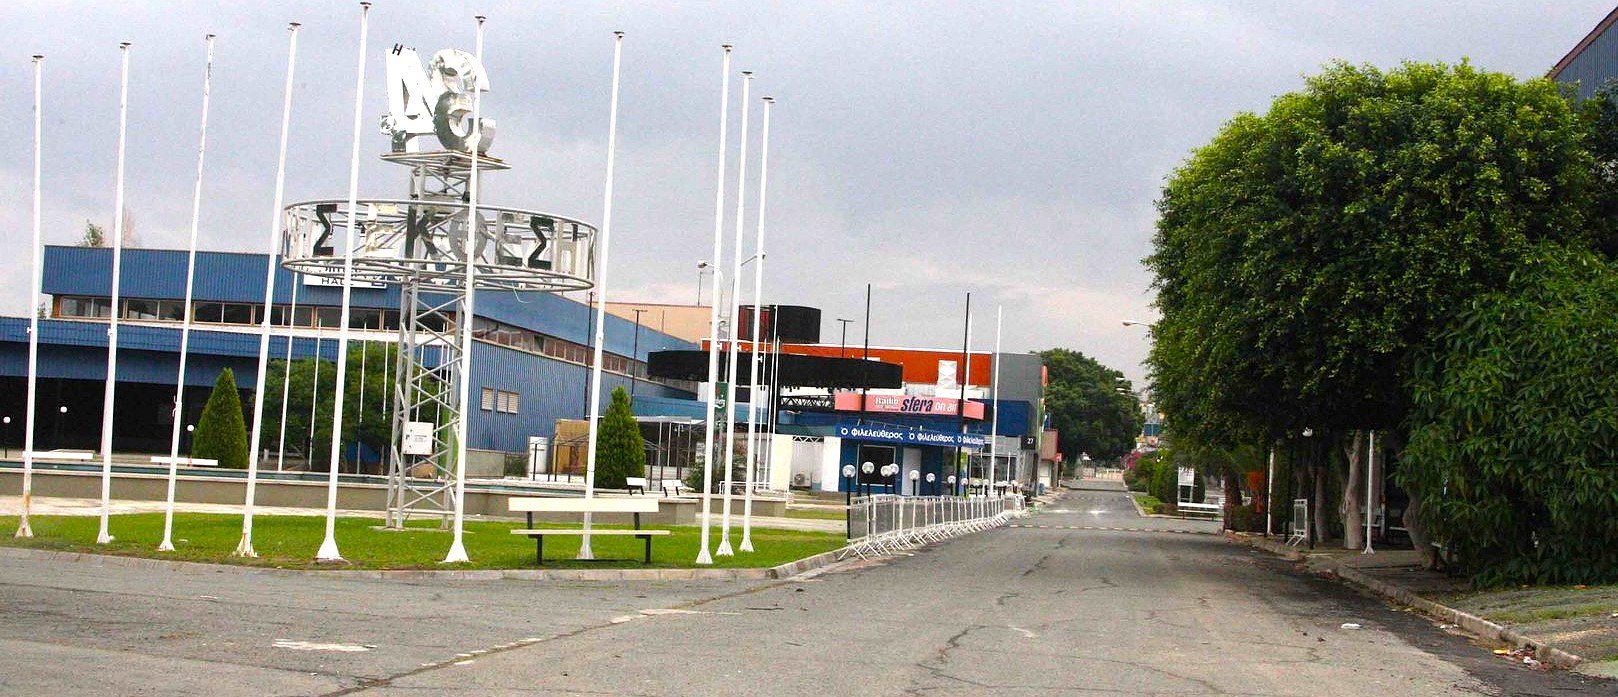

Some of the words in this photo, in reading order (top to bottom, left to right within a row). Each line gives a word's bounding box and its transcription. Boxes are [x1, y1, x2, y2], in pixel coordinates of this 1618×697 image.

[900, 396, 934, 412] sfera
[935, 401, 946, 411] on
[1026, 437, 1034, 445] 27
